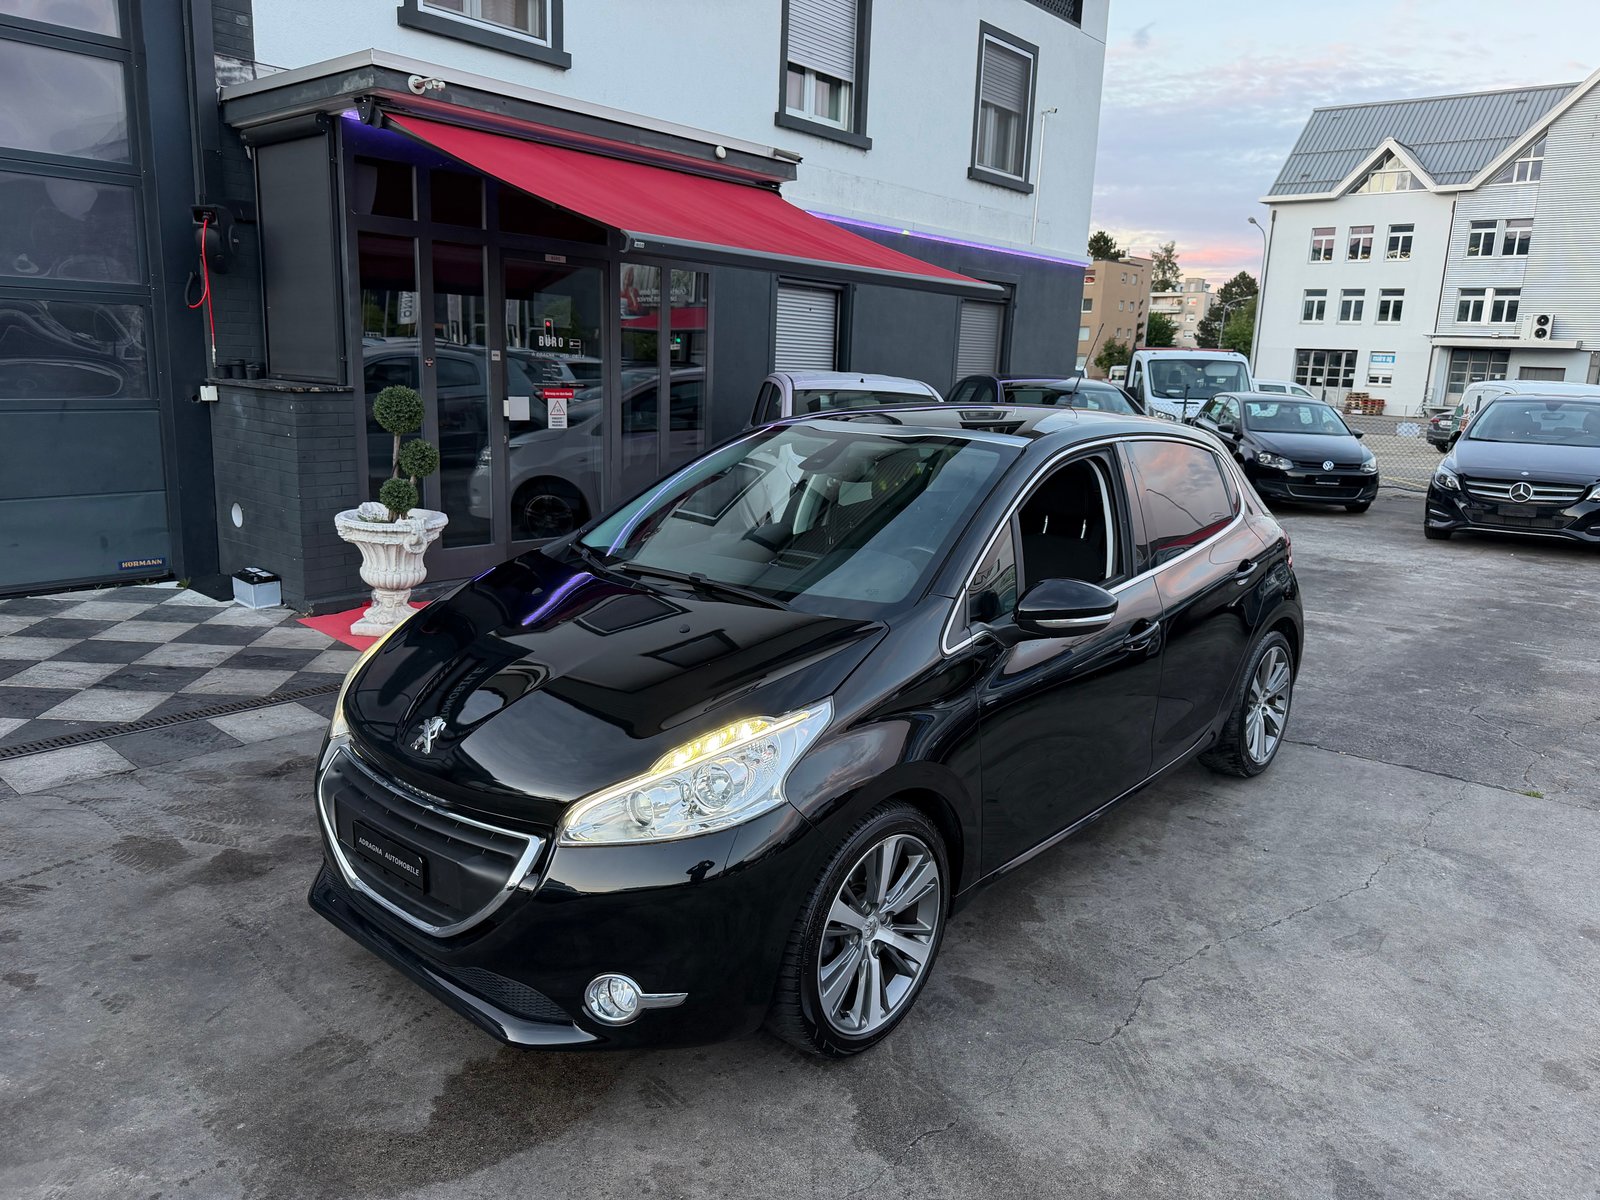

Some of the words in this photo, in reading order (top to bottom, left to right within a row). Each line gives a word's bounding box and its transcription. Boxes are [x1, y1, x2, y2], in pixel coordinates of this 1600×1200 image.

[538, 335, 564, 348] BÜRO
[359, 837, 383, 856] ADRAGNA
[384, 852, 420, 877] AUTOMOBILE
